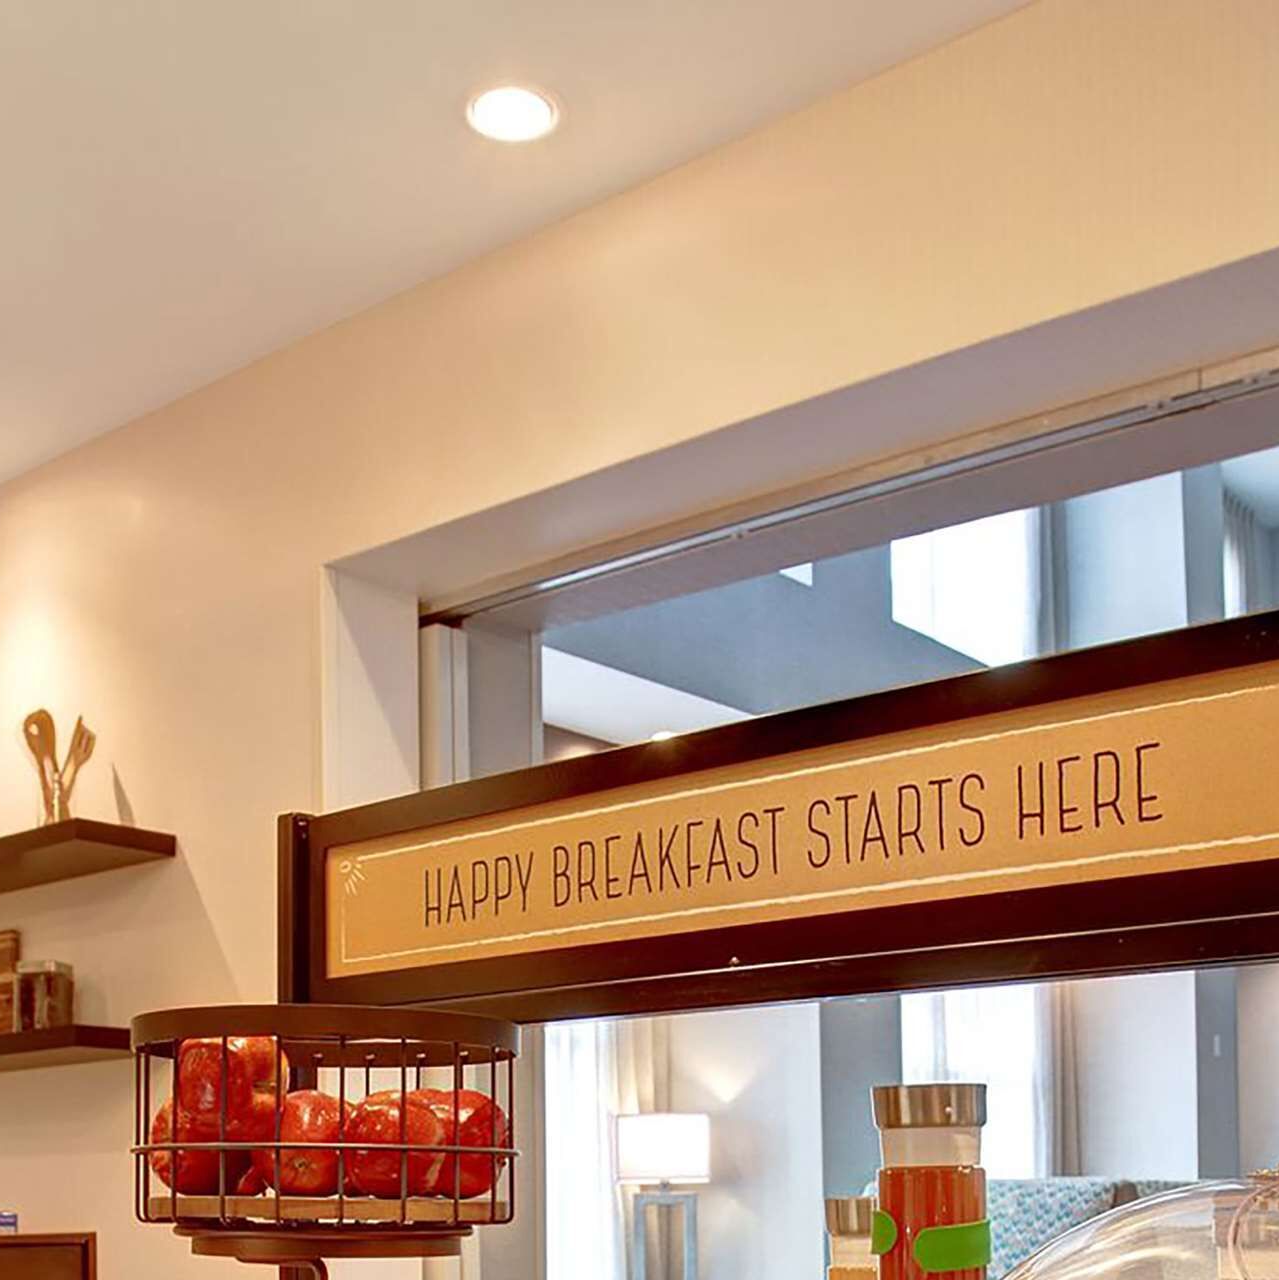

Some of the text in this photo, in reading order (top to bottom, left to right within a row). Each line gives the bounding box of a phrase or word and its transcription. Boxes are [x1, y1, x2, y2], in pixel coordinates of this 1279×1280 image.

[424, 742, 1163, 928] HAPPY BREAKFAST STARTS HERE
